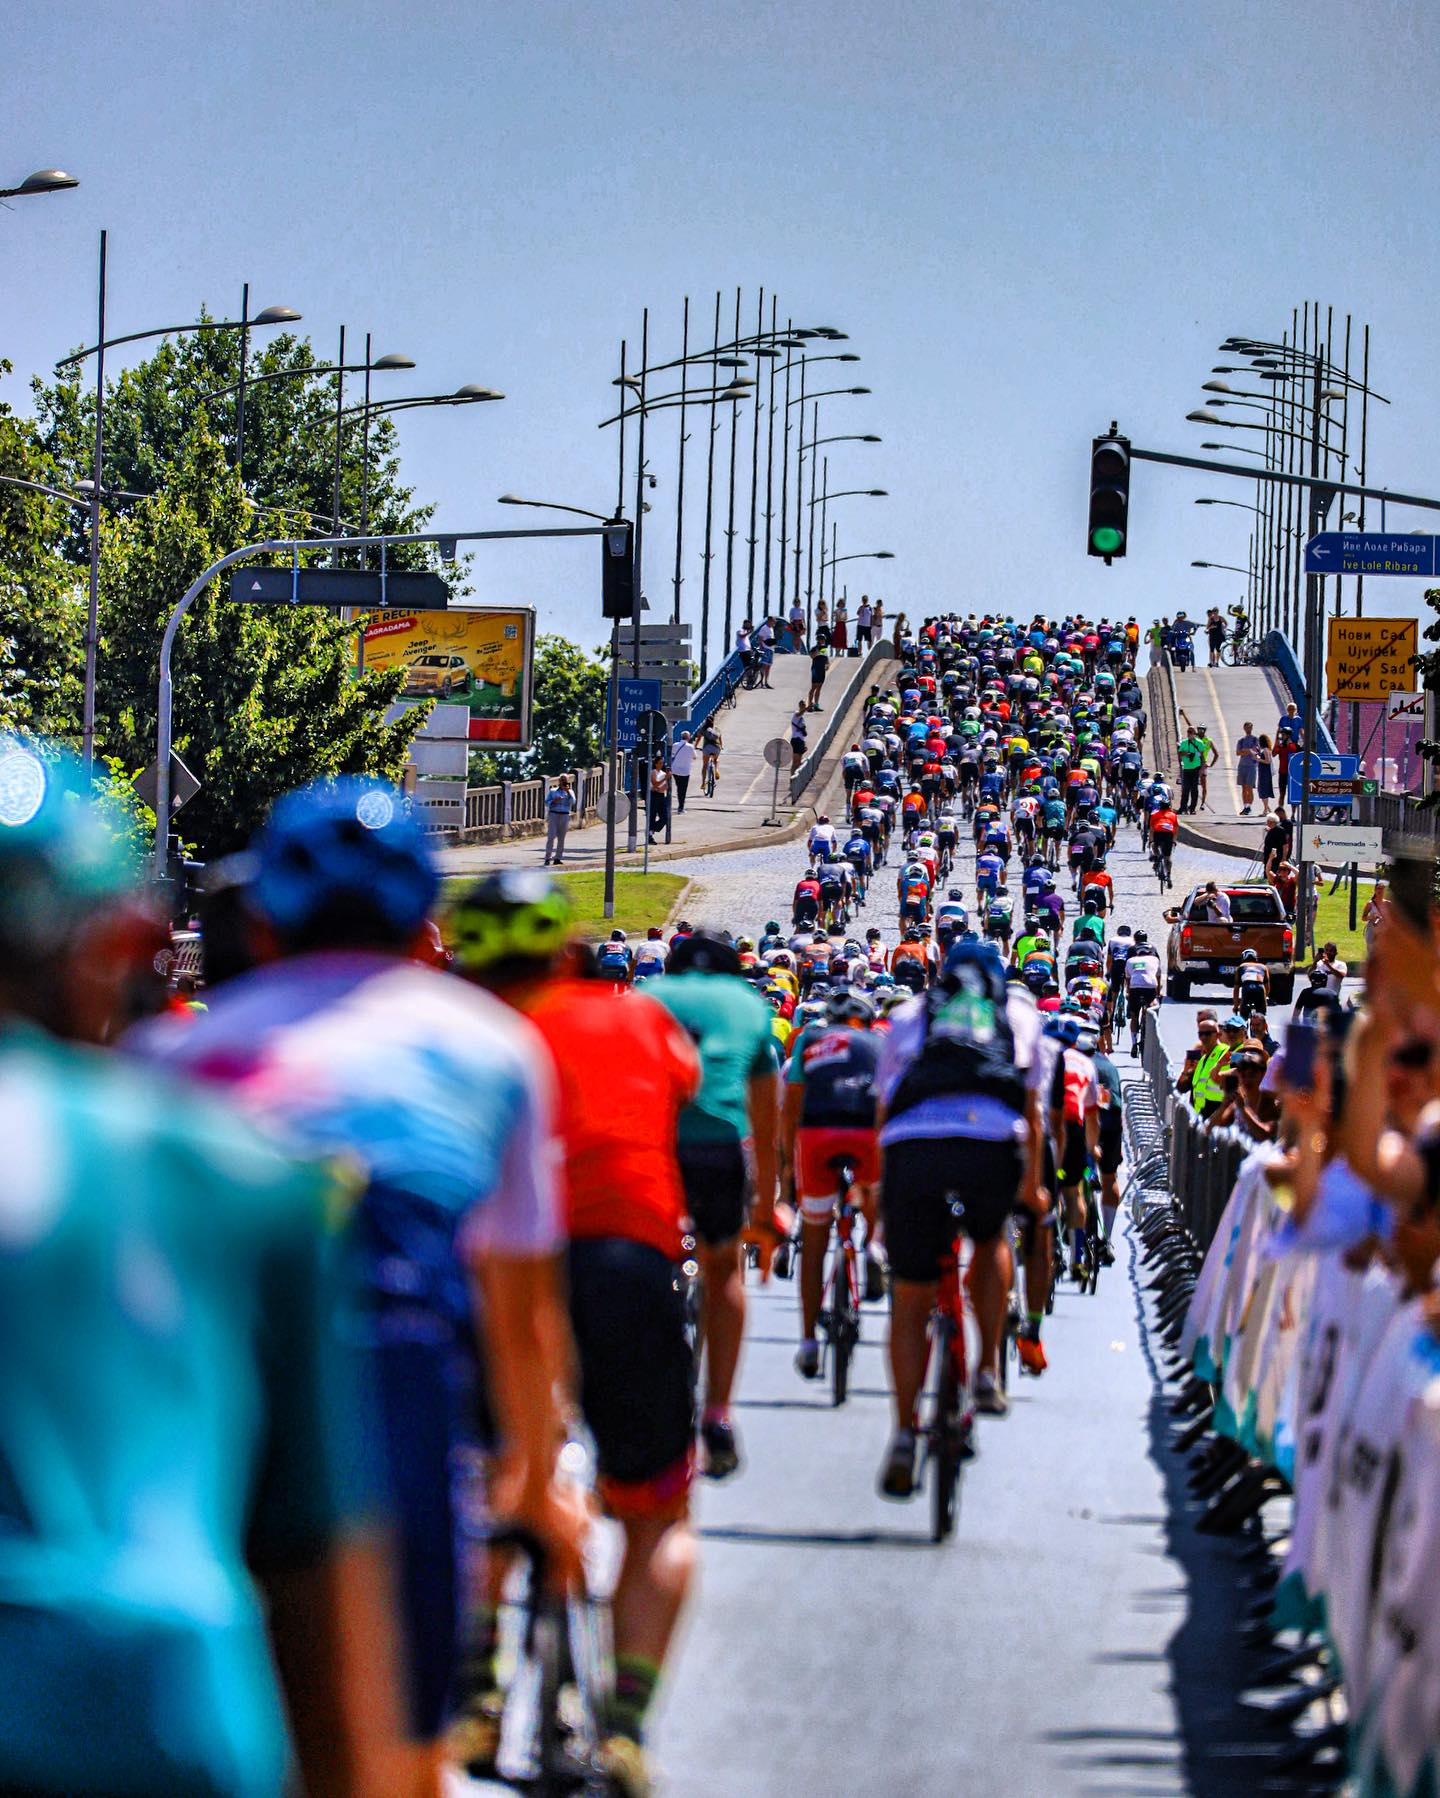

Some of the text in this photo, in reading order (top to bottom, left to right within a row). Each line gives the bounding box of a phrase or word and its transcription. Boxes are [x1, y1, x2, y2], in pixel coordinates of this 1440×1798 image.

[1343, 541, 1427, 554] Иве Лоле Рибара
[1343, 560, 1418, 572] Ive Lole Ribara
[1338, 629, 1406, 641] Нови Сад
[408, 639, 428, 649] Jeep
[403, 645, 436, 657] Avenger
[1381, 662, 1405, 674] Sad
[1337, 678, 1405, 690] Нови Сад
[617, 698, 652, 714] Дунав
